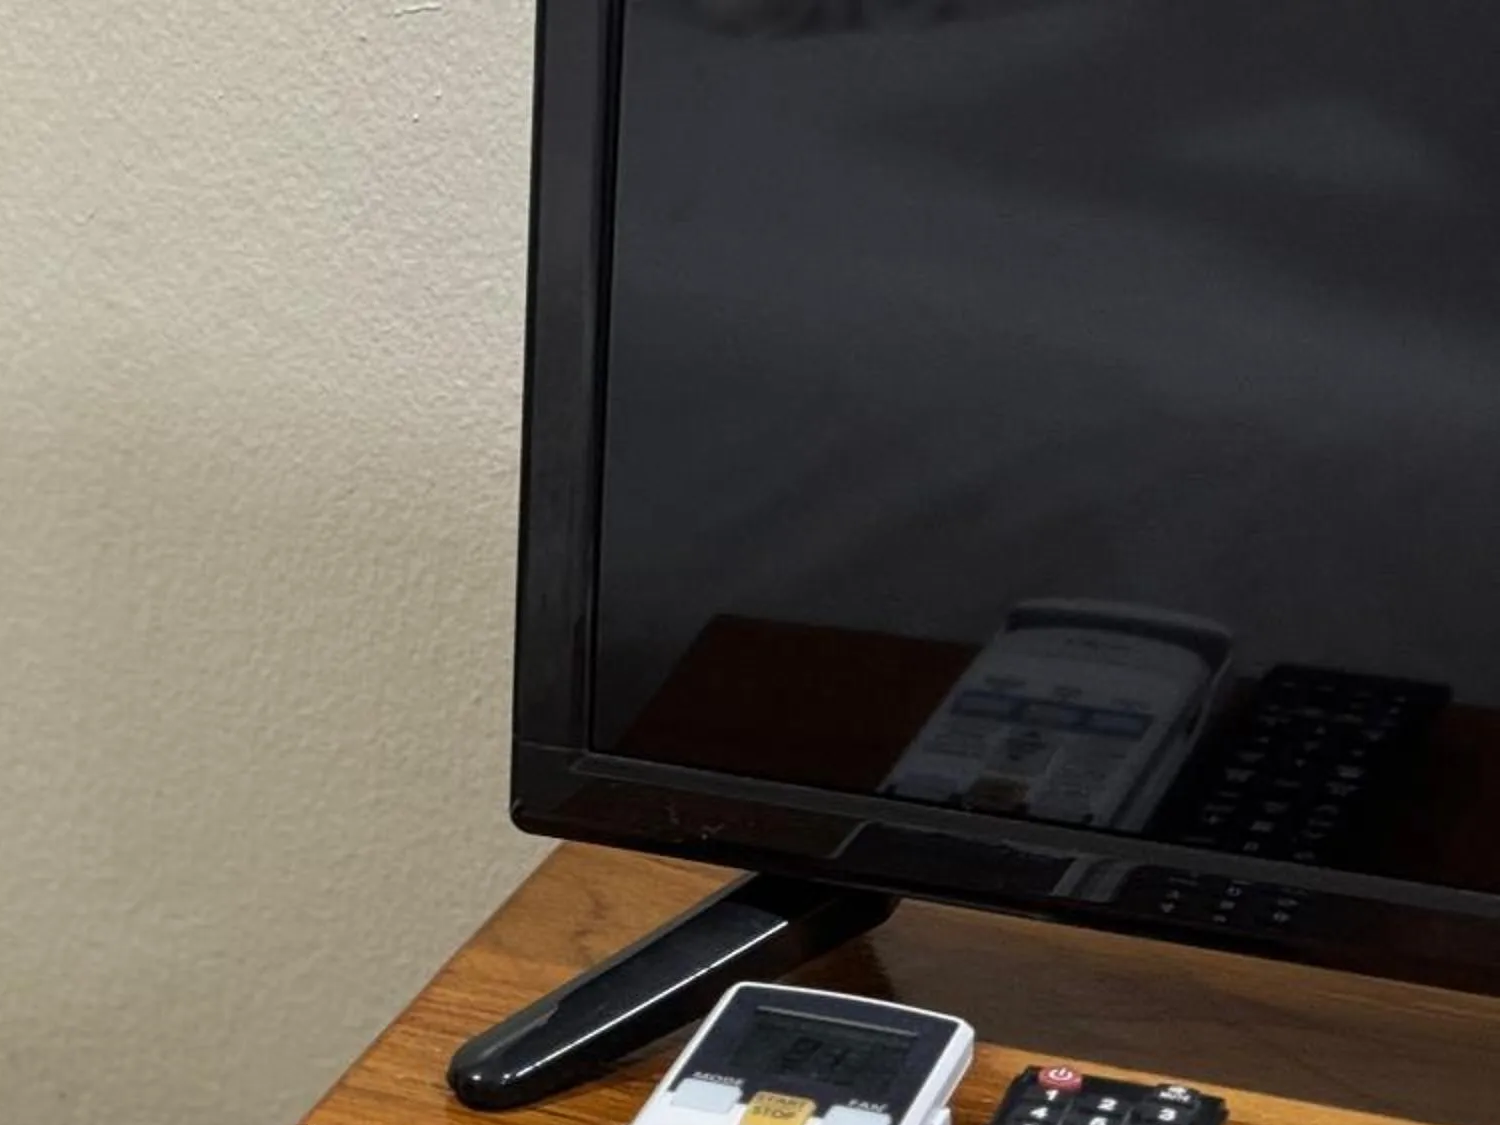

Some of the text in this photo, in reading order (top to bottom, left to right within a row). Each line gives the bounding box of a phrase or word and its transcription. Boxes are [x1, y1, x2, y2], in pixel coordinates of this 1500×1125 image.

[1046, 1089, 1059, 1101] 1
[1097, 1098, 1119, 1112] 2
[751, 1106, 797, 1121] STOP
[1030, 1106, 1049, 1119] 4
[1157, 1107, 1178, 1122] 3
